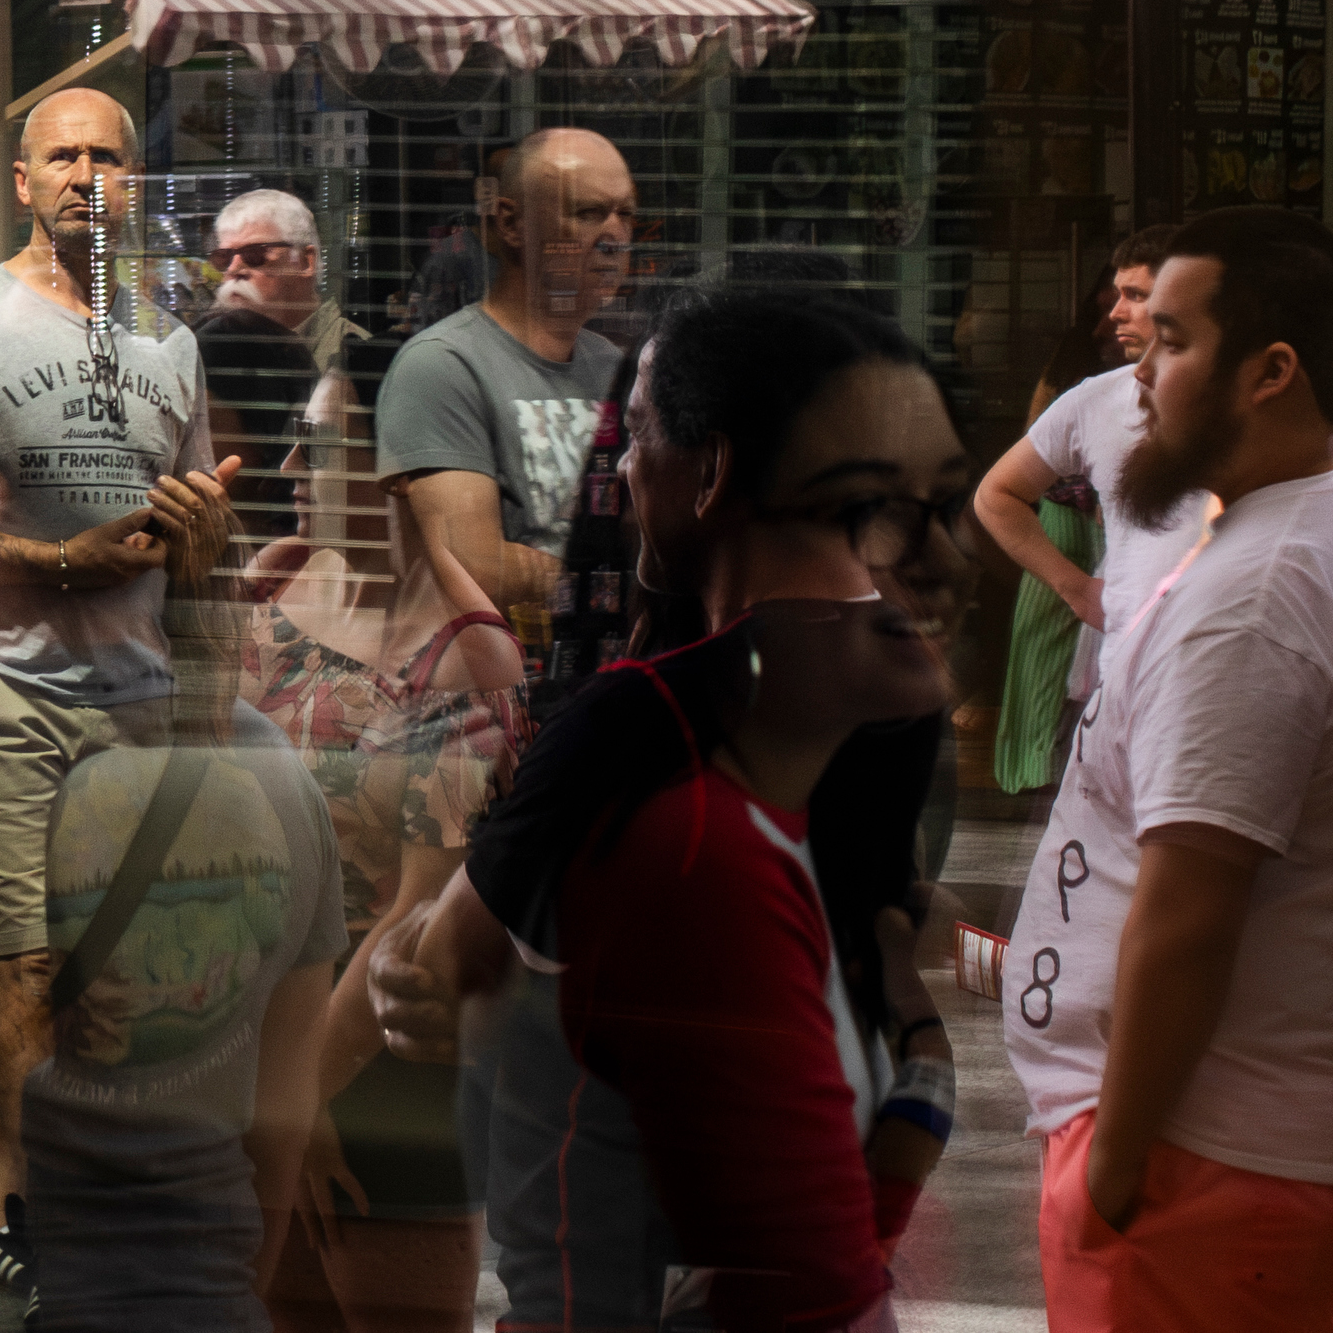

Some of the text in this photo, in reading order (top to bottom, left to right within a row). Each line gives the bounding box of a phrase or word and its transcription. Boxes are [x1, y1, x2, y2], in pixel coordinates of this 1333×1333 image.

[19, 452, 134, 471] SAN FRANCISCO
[48, 470, 74, 482] WITH
